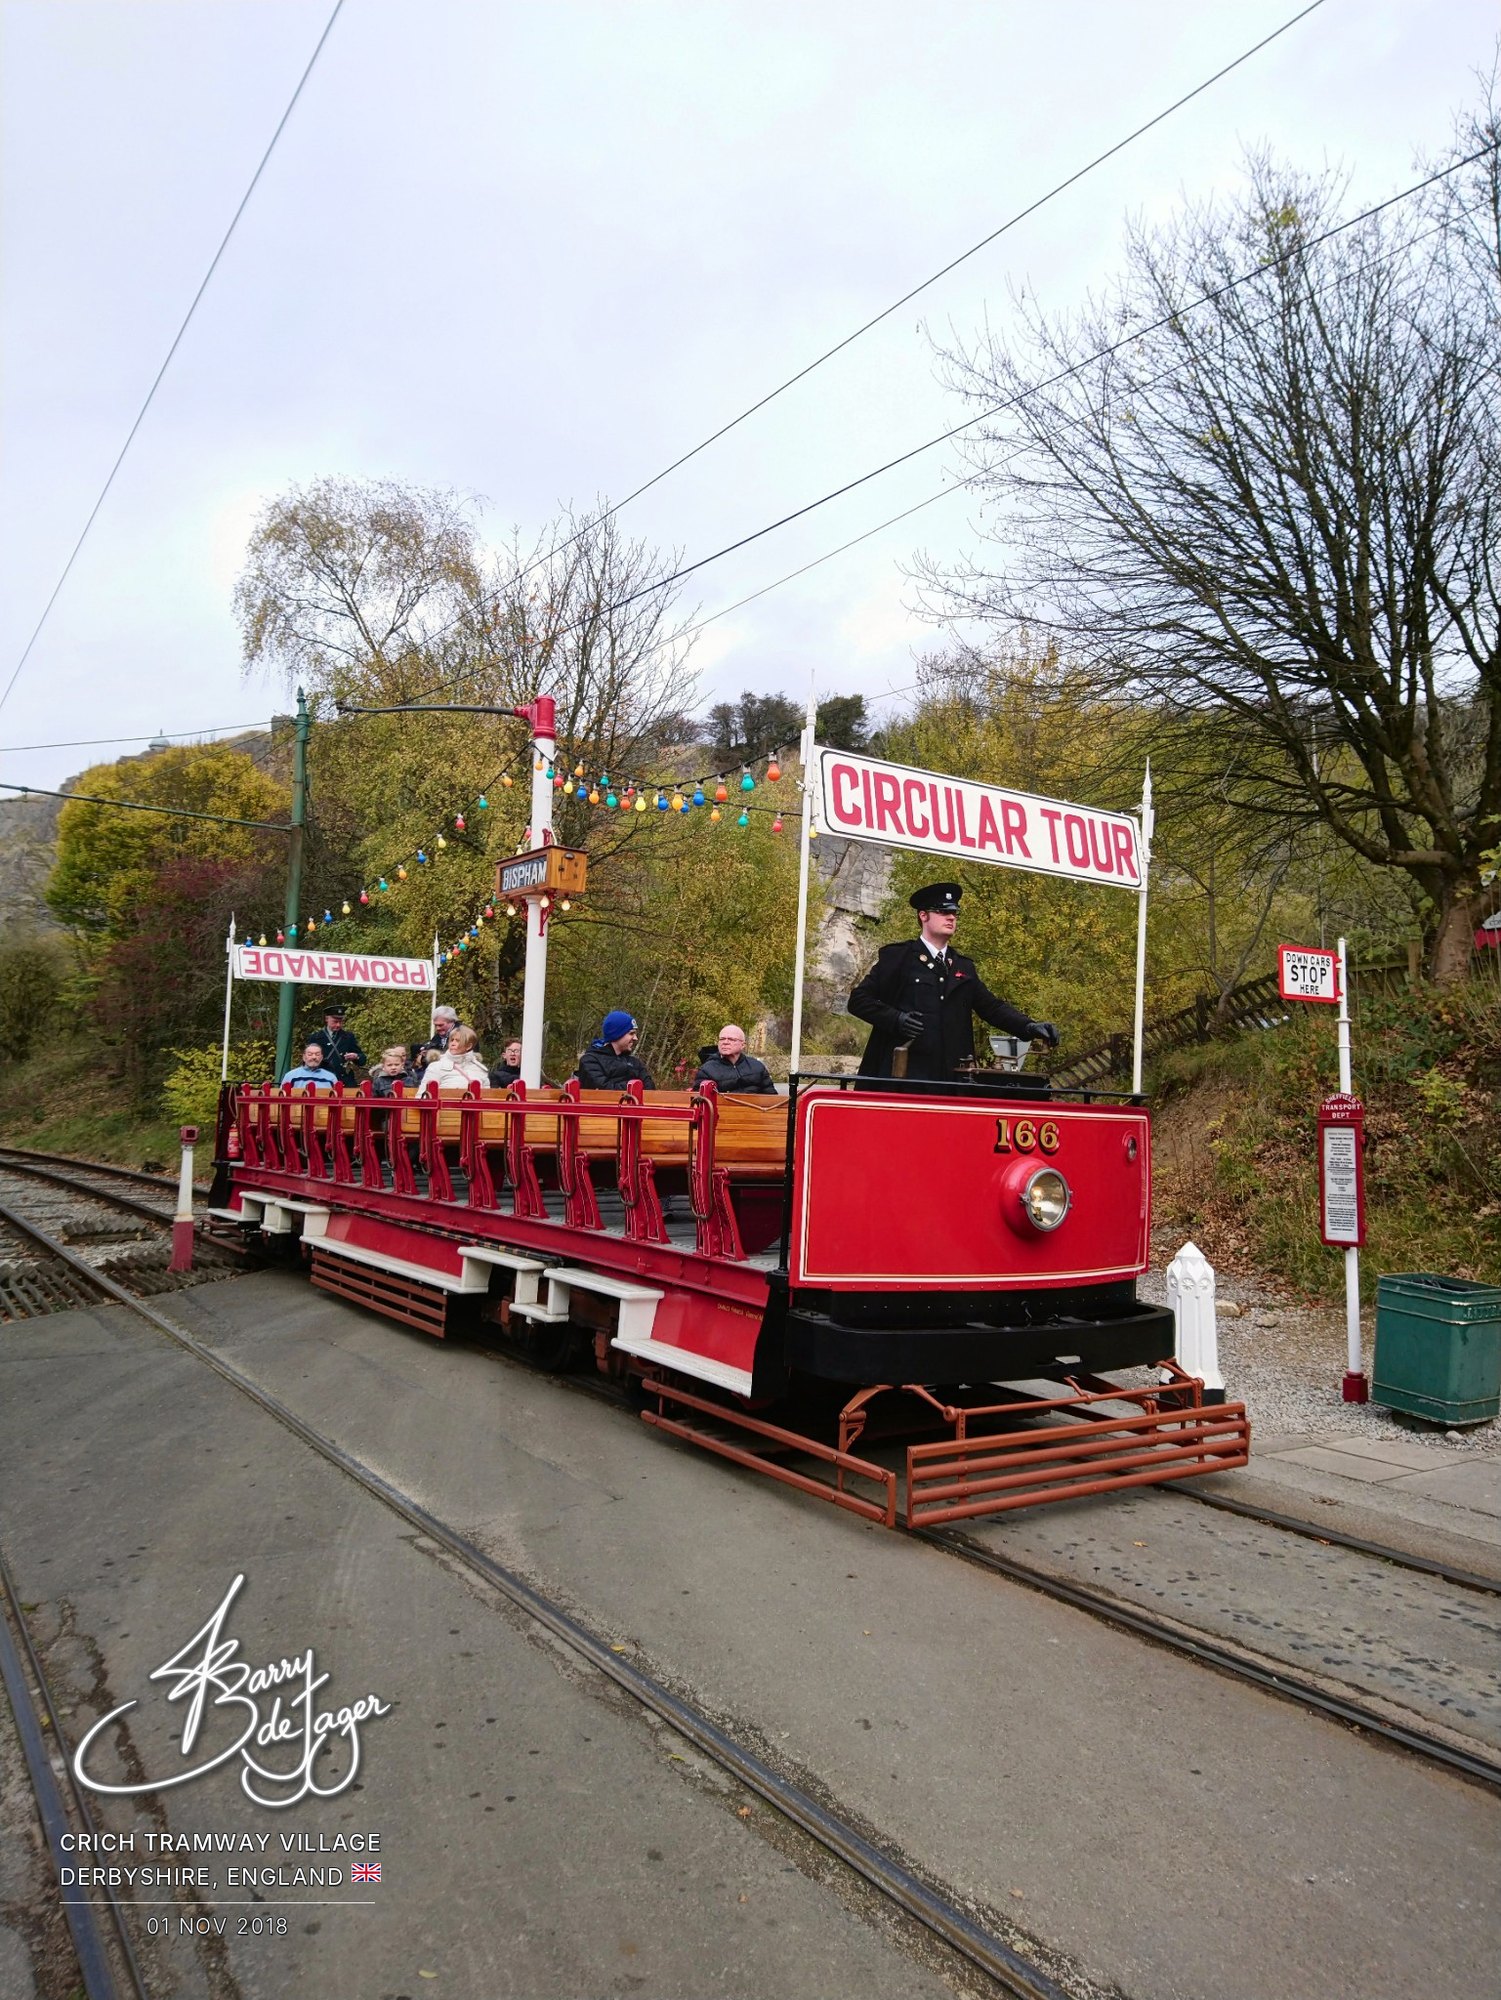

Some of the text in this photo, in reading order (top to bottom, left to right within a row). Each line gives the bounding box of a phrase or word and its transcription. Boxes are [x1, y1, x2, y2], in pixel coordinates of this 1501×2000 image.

[831, 762, 1139, 879] CIRCULAR TOUR
[502, 861, 547, 890] BISPHAM
[242, 950, 427, 986] PROMENADE
[1286, 952, 1331, 967] DOWN CARS
[1291, 964, 1327, 984] STOP
[1299, 984, 1320, 995] HERE
[1321, 1103, 1361, 1111] TRANSPORT
[1325, 1093, 1357, 1104] SHEFFIELD
[1331, 1111, 1351, 1119] DEPT
[994, 1118, 1060, 1156] 166
